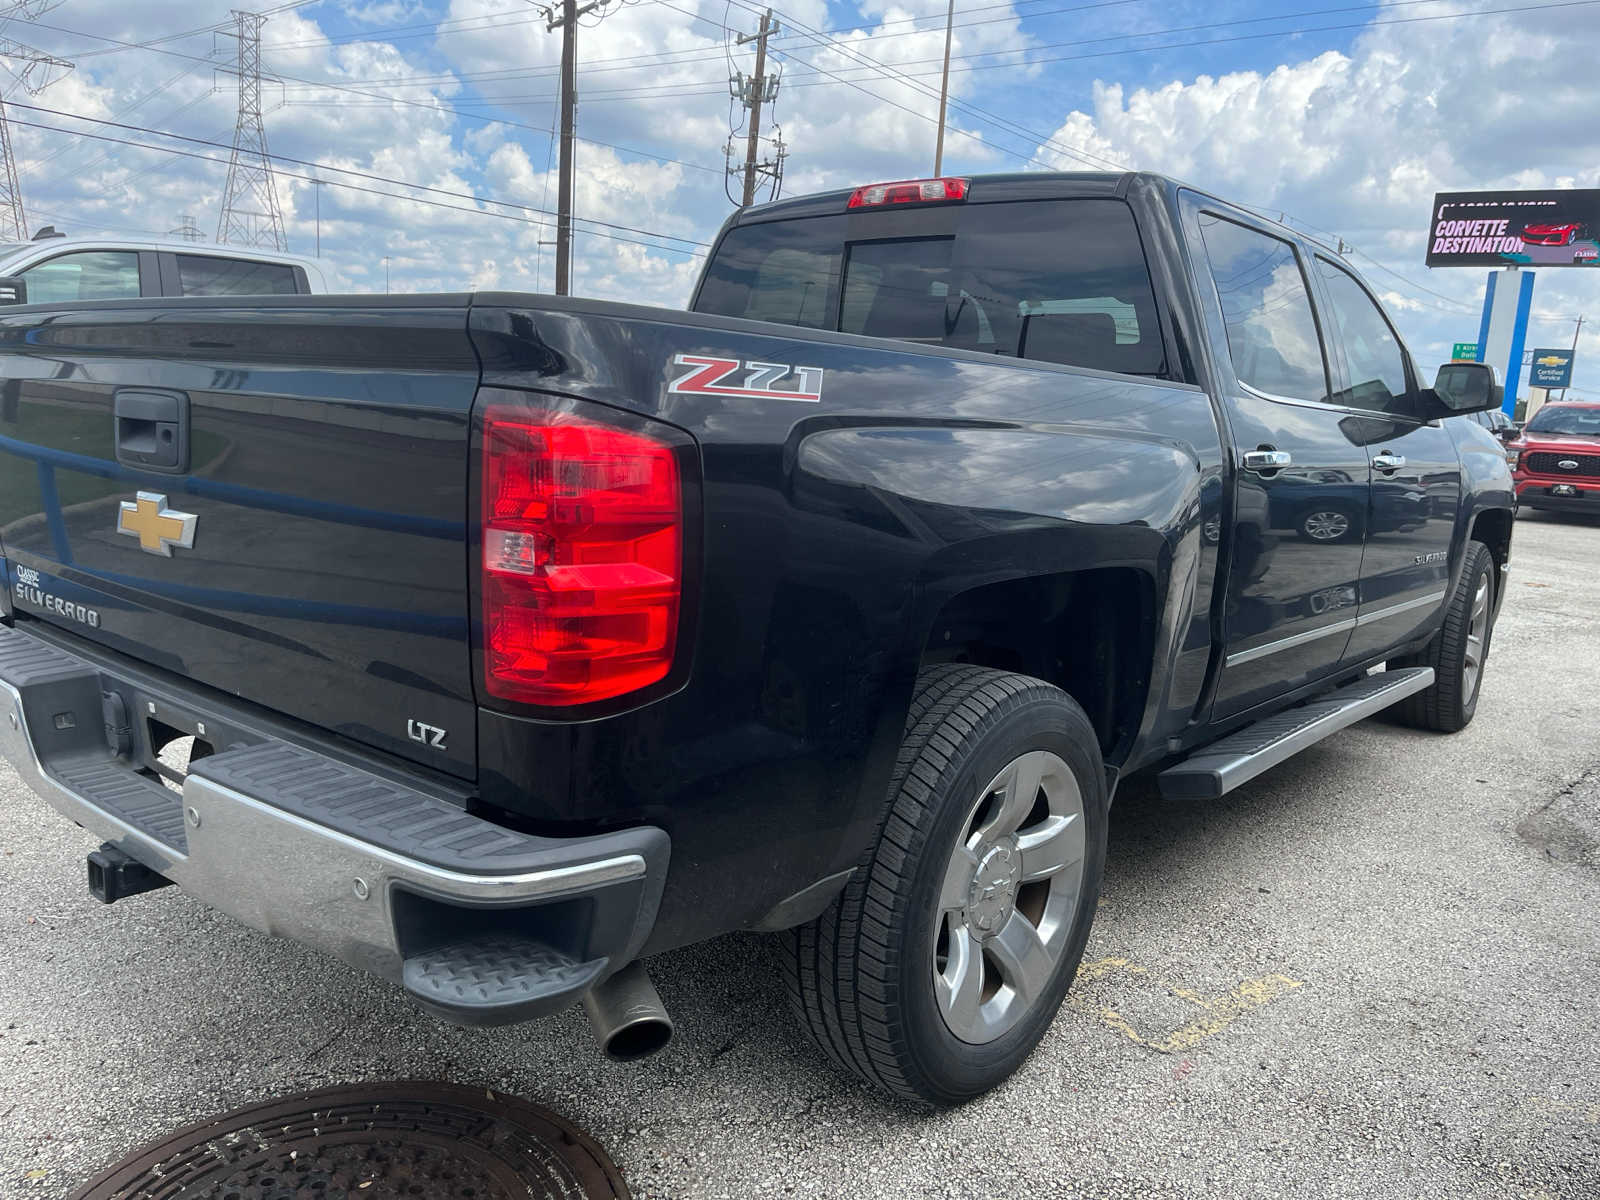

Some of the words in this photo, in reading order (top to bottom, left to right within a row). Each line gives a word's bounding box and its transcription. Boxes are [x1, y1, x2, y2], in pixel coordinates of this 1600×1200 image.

[1435, 219, 1509, 237] CORVETTE
[1431, 236, 1525, 254] DESTINATION
[668, 354, 823, 402] Z71
[16, 582, 98, 628] SILVERADO
[407, 719, 447, 750] LTZ
